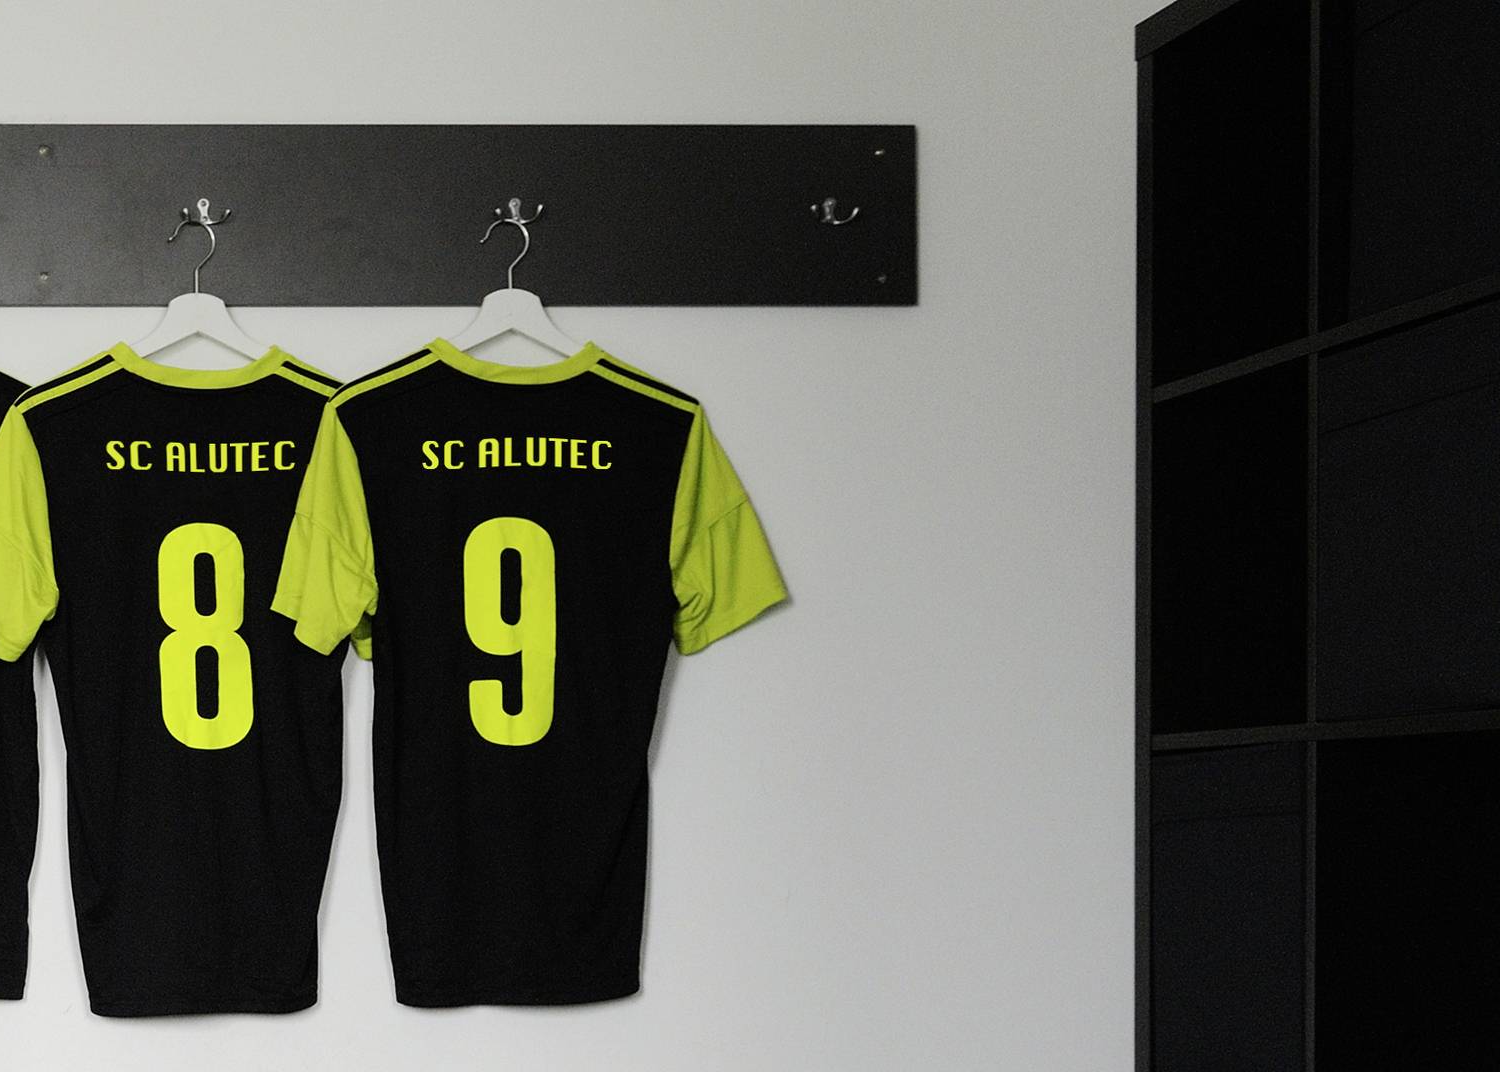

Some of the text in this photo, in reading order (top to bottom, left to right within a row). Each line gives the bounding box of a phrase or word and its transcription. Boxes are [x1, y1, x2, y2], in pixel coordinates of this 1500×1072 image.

[105, 440, 296, 473] SC ALUTEC
[421, 436, 612, 470] SC ALUTEC
[157, 522, 254, 750] 8
[463, 516, 557, 747] 9
